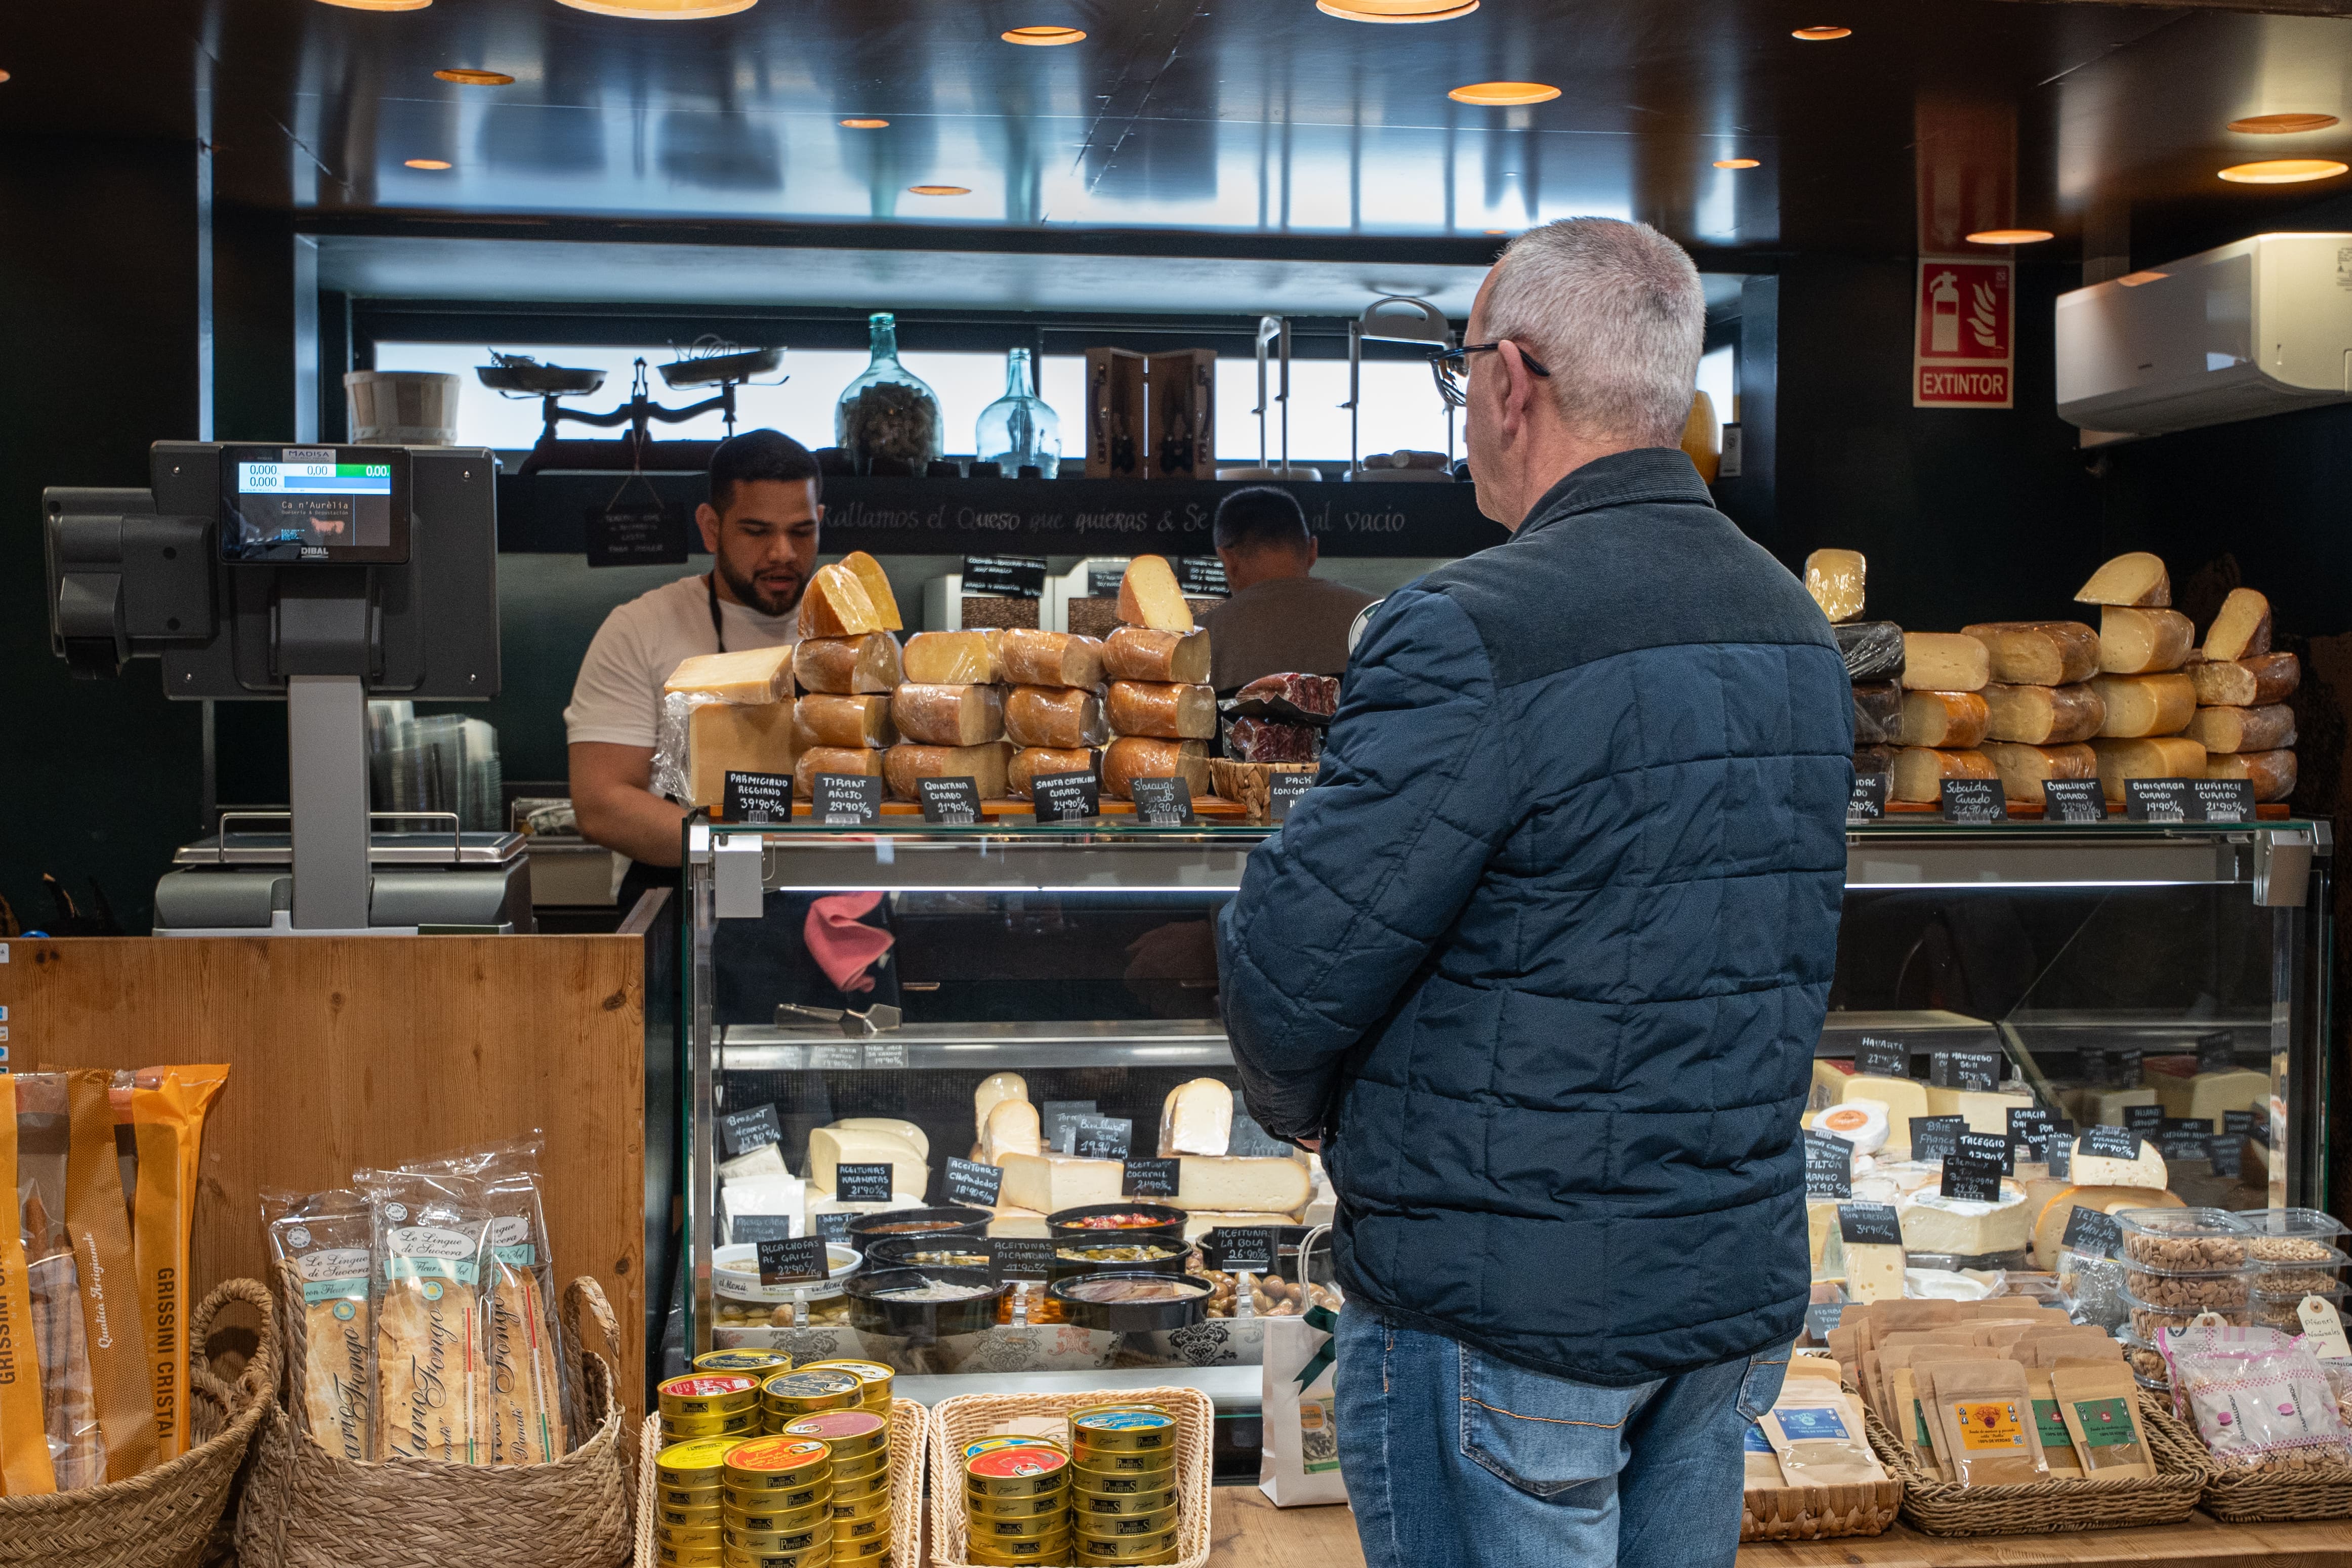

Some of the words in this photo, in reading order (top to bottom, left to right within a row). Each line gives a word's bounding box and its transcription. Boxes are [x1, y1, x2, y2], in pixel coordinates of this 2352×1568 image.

[1923, 373, 2003, 395] EXTINTOR
[250, 465, 277, 475] 0,000
[307, 466, 327, 475] 0,00
[250, 477, 277, 487] 0,000
[299, 501, 348, 509] n'Aurèlia
[959, 507, 1020, 530] Queso
[1158, 510, 1175, 532] &
[730, 773, 788, 787] PARMIGIANO
[823, 777, 866, 788] TIRANT
[1036, 780, 1063, 790] SANTA
[1064, 775, 1096, 786] CATALINA
[1285, 776, 1312, 785] PACK
[738, 786, 780, 796] REGGIANO
[924, 782, 968, 791] QUINTANA
[1273, 787, 1310, 796] LONGA
[828, 789, 862, 800] AÑEJO
[930, 792, 962, 800] CURADO
[1049, 789, 1081, 798] CURADO
[2056, 792, 2088, 801] CURADO
[2139, 792, 2171, 800] CURADO
[2199, 792, 2238, 800] CURADO
[1952, 1052, 1992, 1062] MANCHEGO
[2014, 1110, 2046, 1120] GARCIA
[1960, 1135, 2005, 1148] TALEGGIO
[840, 1166, 885, 1174] ACEITUNAS
[842, 1176, 889, 1184] KALAMATAS
[1805, 1173, 1838, 1182] MANGO
[1217, 1229, 1272, 1237] ACEITUNAS
[2076, 1222, 2117, 1240] MOINE
[400, 1230, 418, 1242] Le
[422, 1232, 462, 1248] Lingue
[1220, 1239, 1233, 1248] LA
[1238, 1239, 1263, 1247] BOLA
[401, 1243, 414, 1253] di
[416, 1243, 462, 1256] Suocera
[761, 1240, 820, 1254] ALCACHOFAS
[995, 1242, 1053, 1251] ACEITUNAS
[305, 1255, 322, 1267] Le
[327, 1254, 368, 1267] Lingue
[762, 1256, 775, 1264] AL
[781, 1253, 814, 1262] GRILL
[413, 1260, 438, 1272] Fleur
[308, 1268, 319, 1278] di
[323, 1265, 369, 1276] Suocera
[321, 1284, 346, 1295] Fleur
[157, 1267, 175, 1353] GRISSINI
[1814, 1307, 1842, 1315] MORBI
[2305, 1317, 2333, 1326] Piñones
[2307, 1330, 2340, 1339] Nacionales
[1117, 1458, 1143, 1468] PEPERETES
[768, 1474, 796, 1487] PEPERETES
[1104, 1480, 1137, 1493] PEPERETES
[1117, 1520, 1150, 1534] PEPERETES
[779, 1534, 812, 1551] PEPERETES
[1013, 1544, 1040, 1554] PEPERETES
